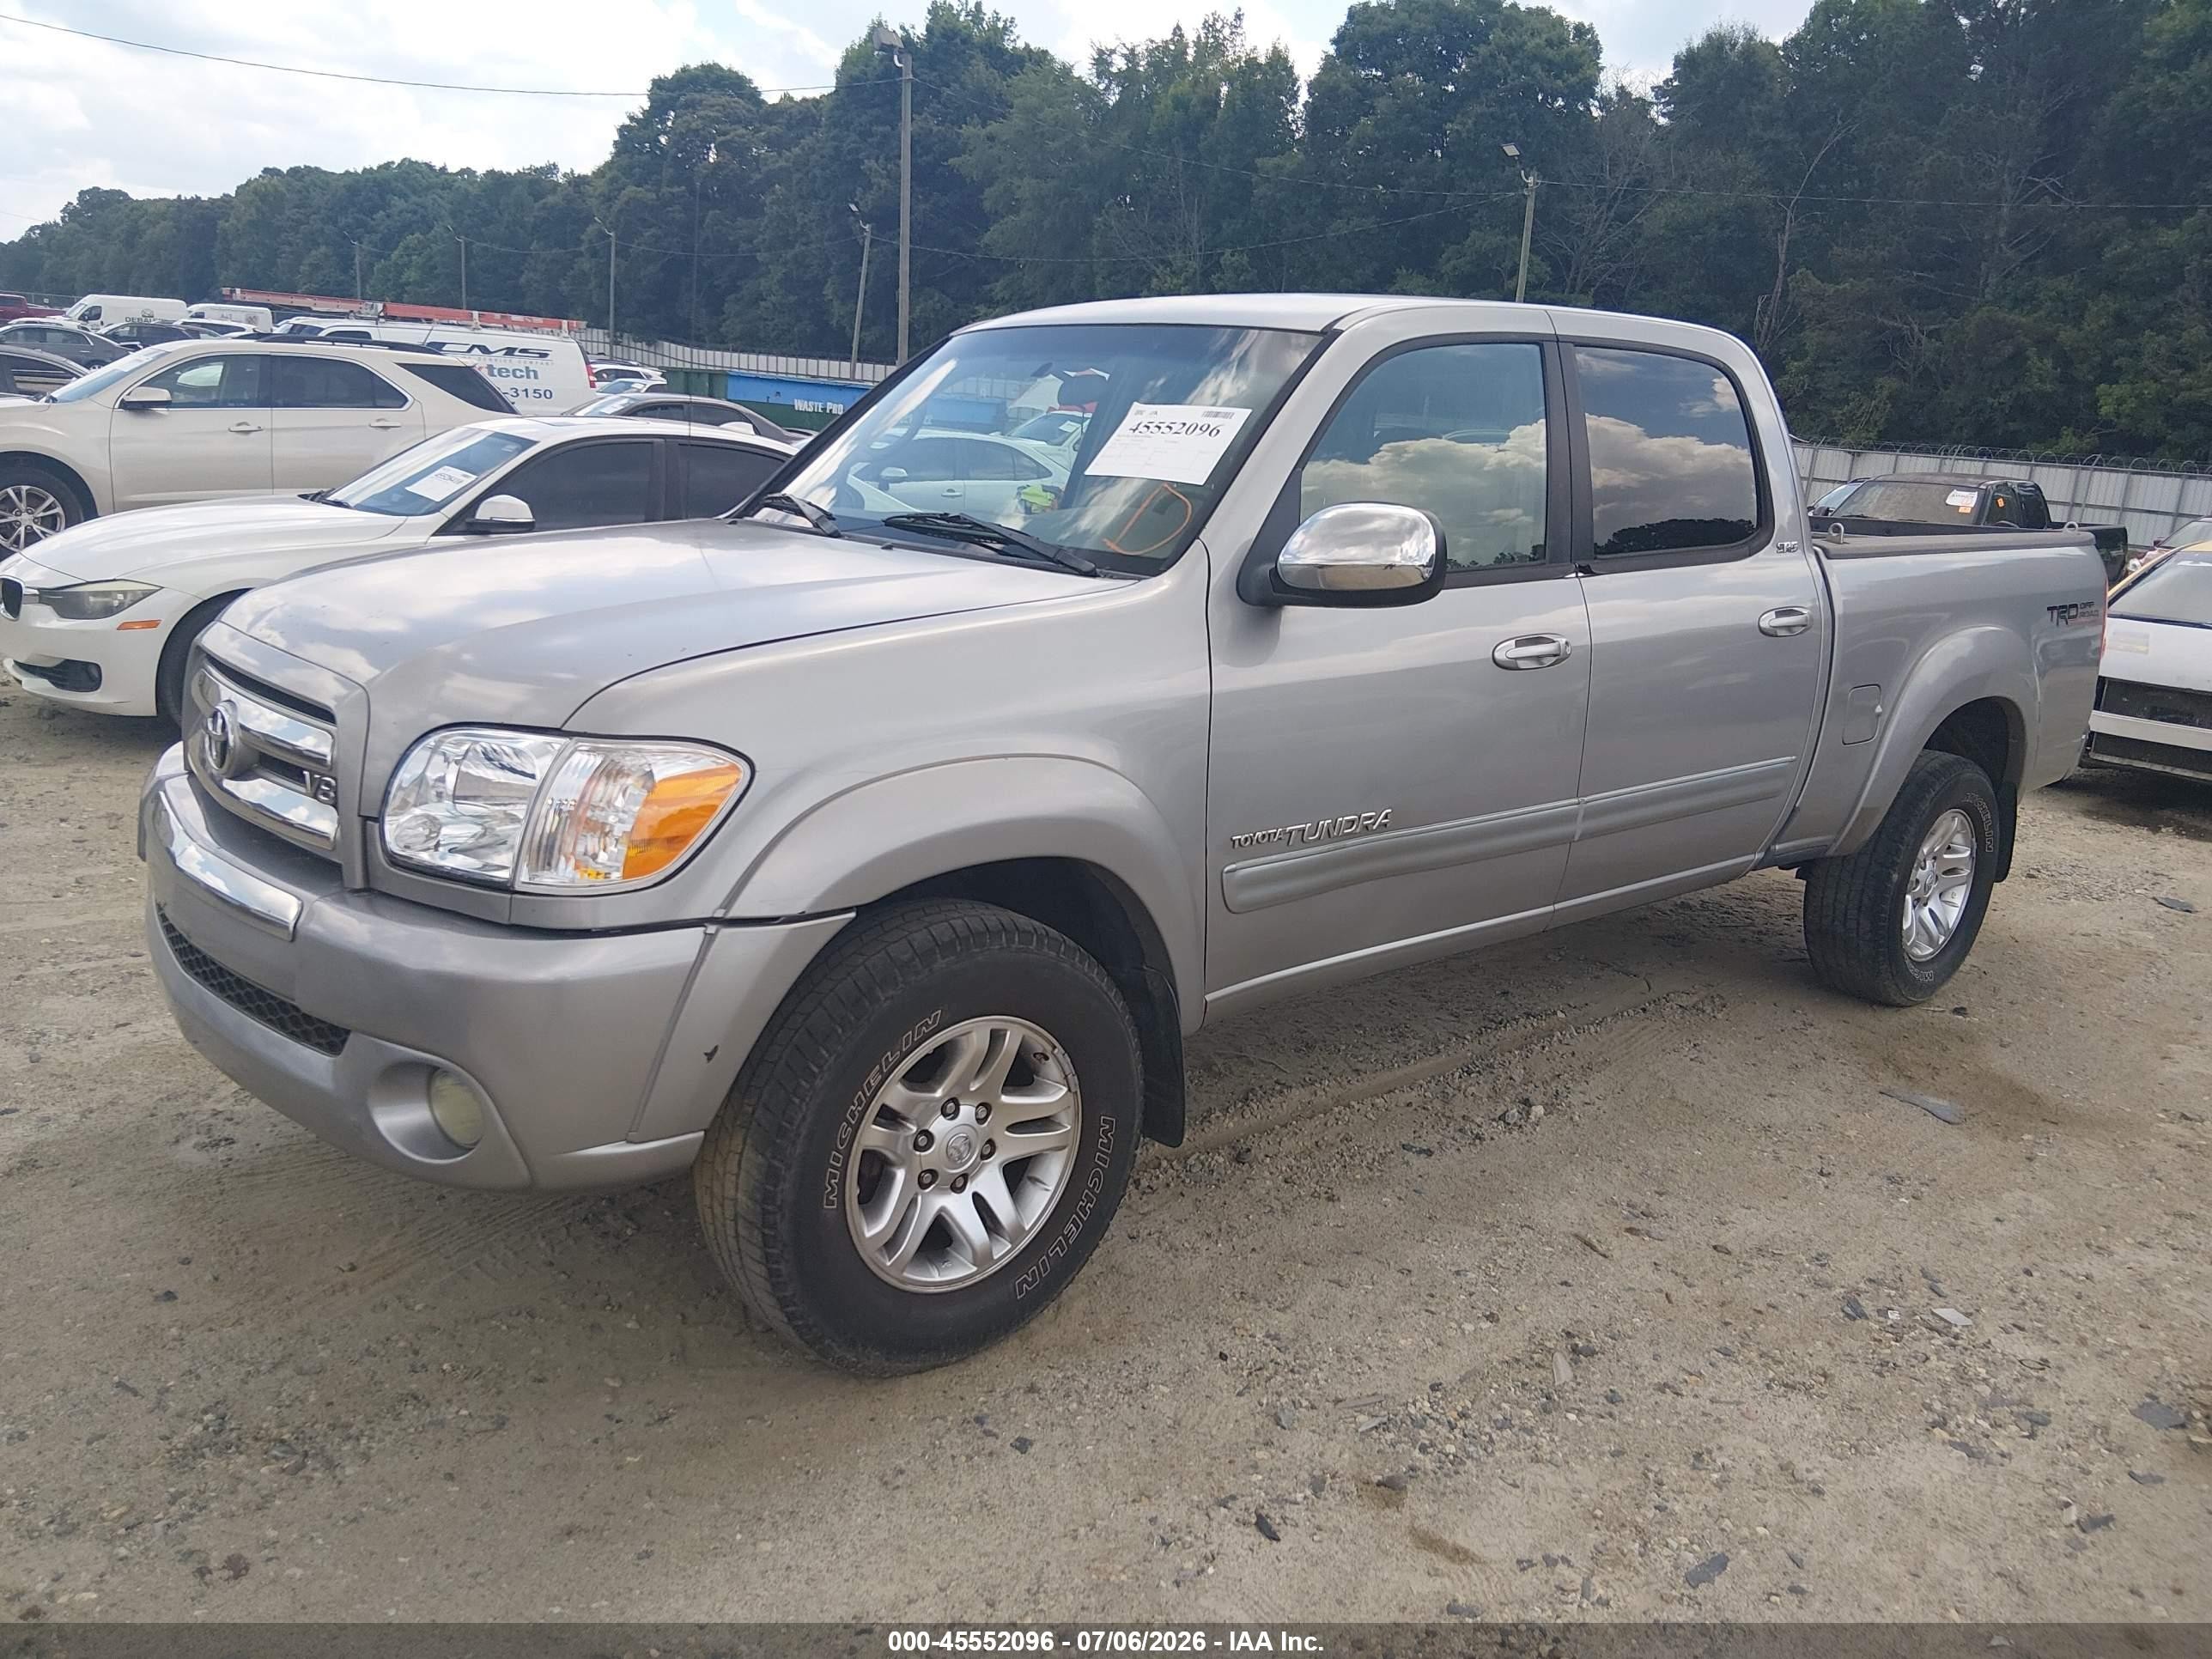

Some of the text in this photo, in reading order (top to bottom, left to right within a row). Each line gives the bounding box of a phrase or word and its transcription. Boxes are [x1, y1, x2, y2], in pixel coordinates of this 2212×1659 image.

[425, 341, 552, 359] CMS
[794, 398, 844, 416] WASTE PRO
[1129, 421, 1226, 439] 45552096
[2046, 603, 2079, 626] TRD
[303, 770, 337, 805] V8
[1231, 809, 1392, 848] TOYOTA TUNDRA
[823, 1010, 941, 1209] MICHELIN
[1015, 1115, 1115, 1299] MICHELIN
